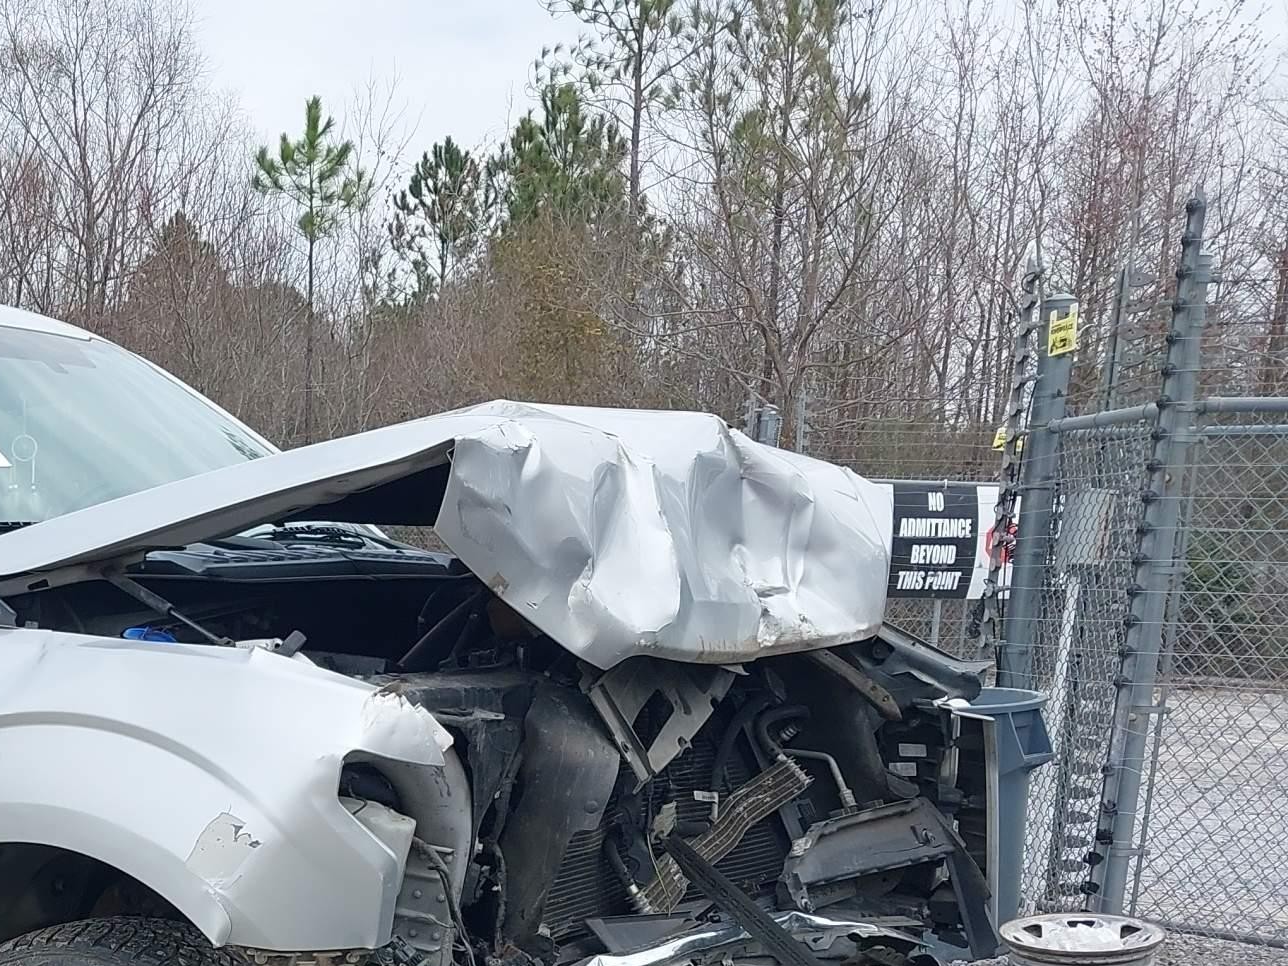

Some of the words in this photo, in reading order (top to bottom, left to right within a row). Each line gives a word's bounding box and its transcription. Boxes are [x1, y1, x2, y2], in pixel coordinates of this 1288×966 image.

[928, 492, 944, 511] NO
[899, 518, 972, 538] ADMITTANCE
[911, 545, 956, 564] BEYOND
[896, 571, 925, 590] THIS
[924, 571, 962, 590] POINT
